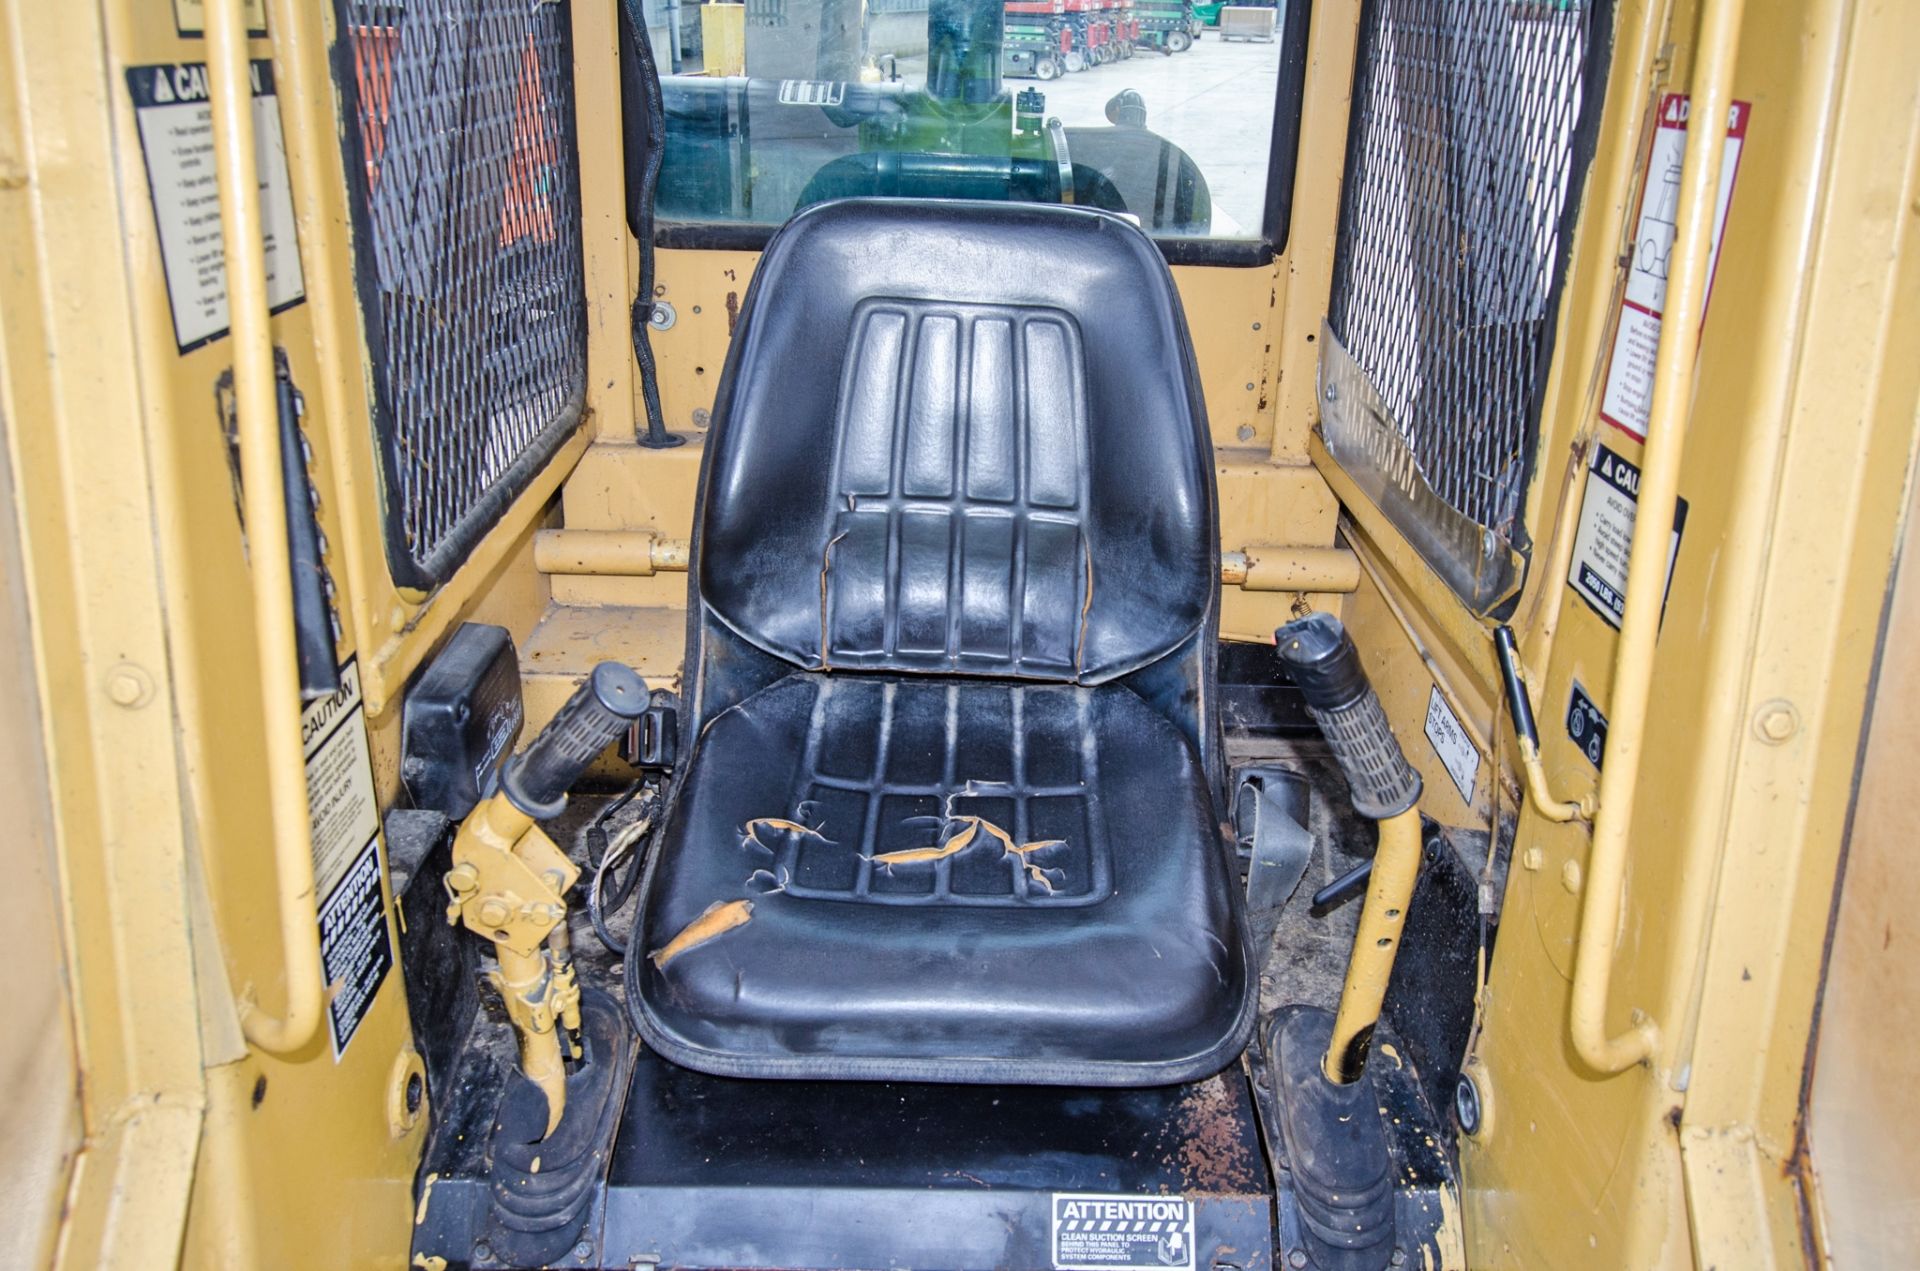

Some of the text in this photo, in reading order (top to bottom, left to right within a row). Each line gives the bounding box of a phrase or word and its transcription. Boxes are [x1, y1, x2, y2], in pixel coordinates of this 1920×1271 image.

[324, 855, 374, 935] ATTENTION
[1063, 1201, 1184, 1220] ATTENTION
[1061, 1233, 1158, 1242] CLEAN SUCTION SCREEN
